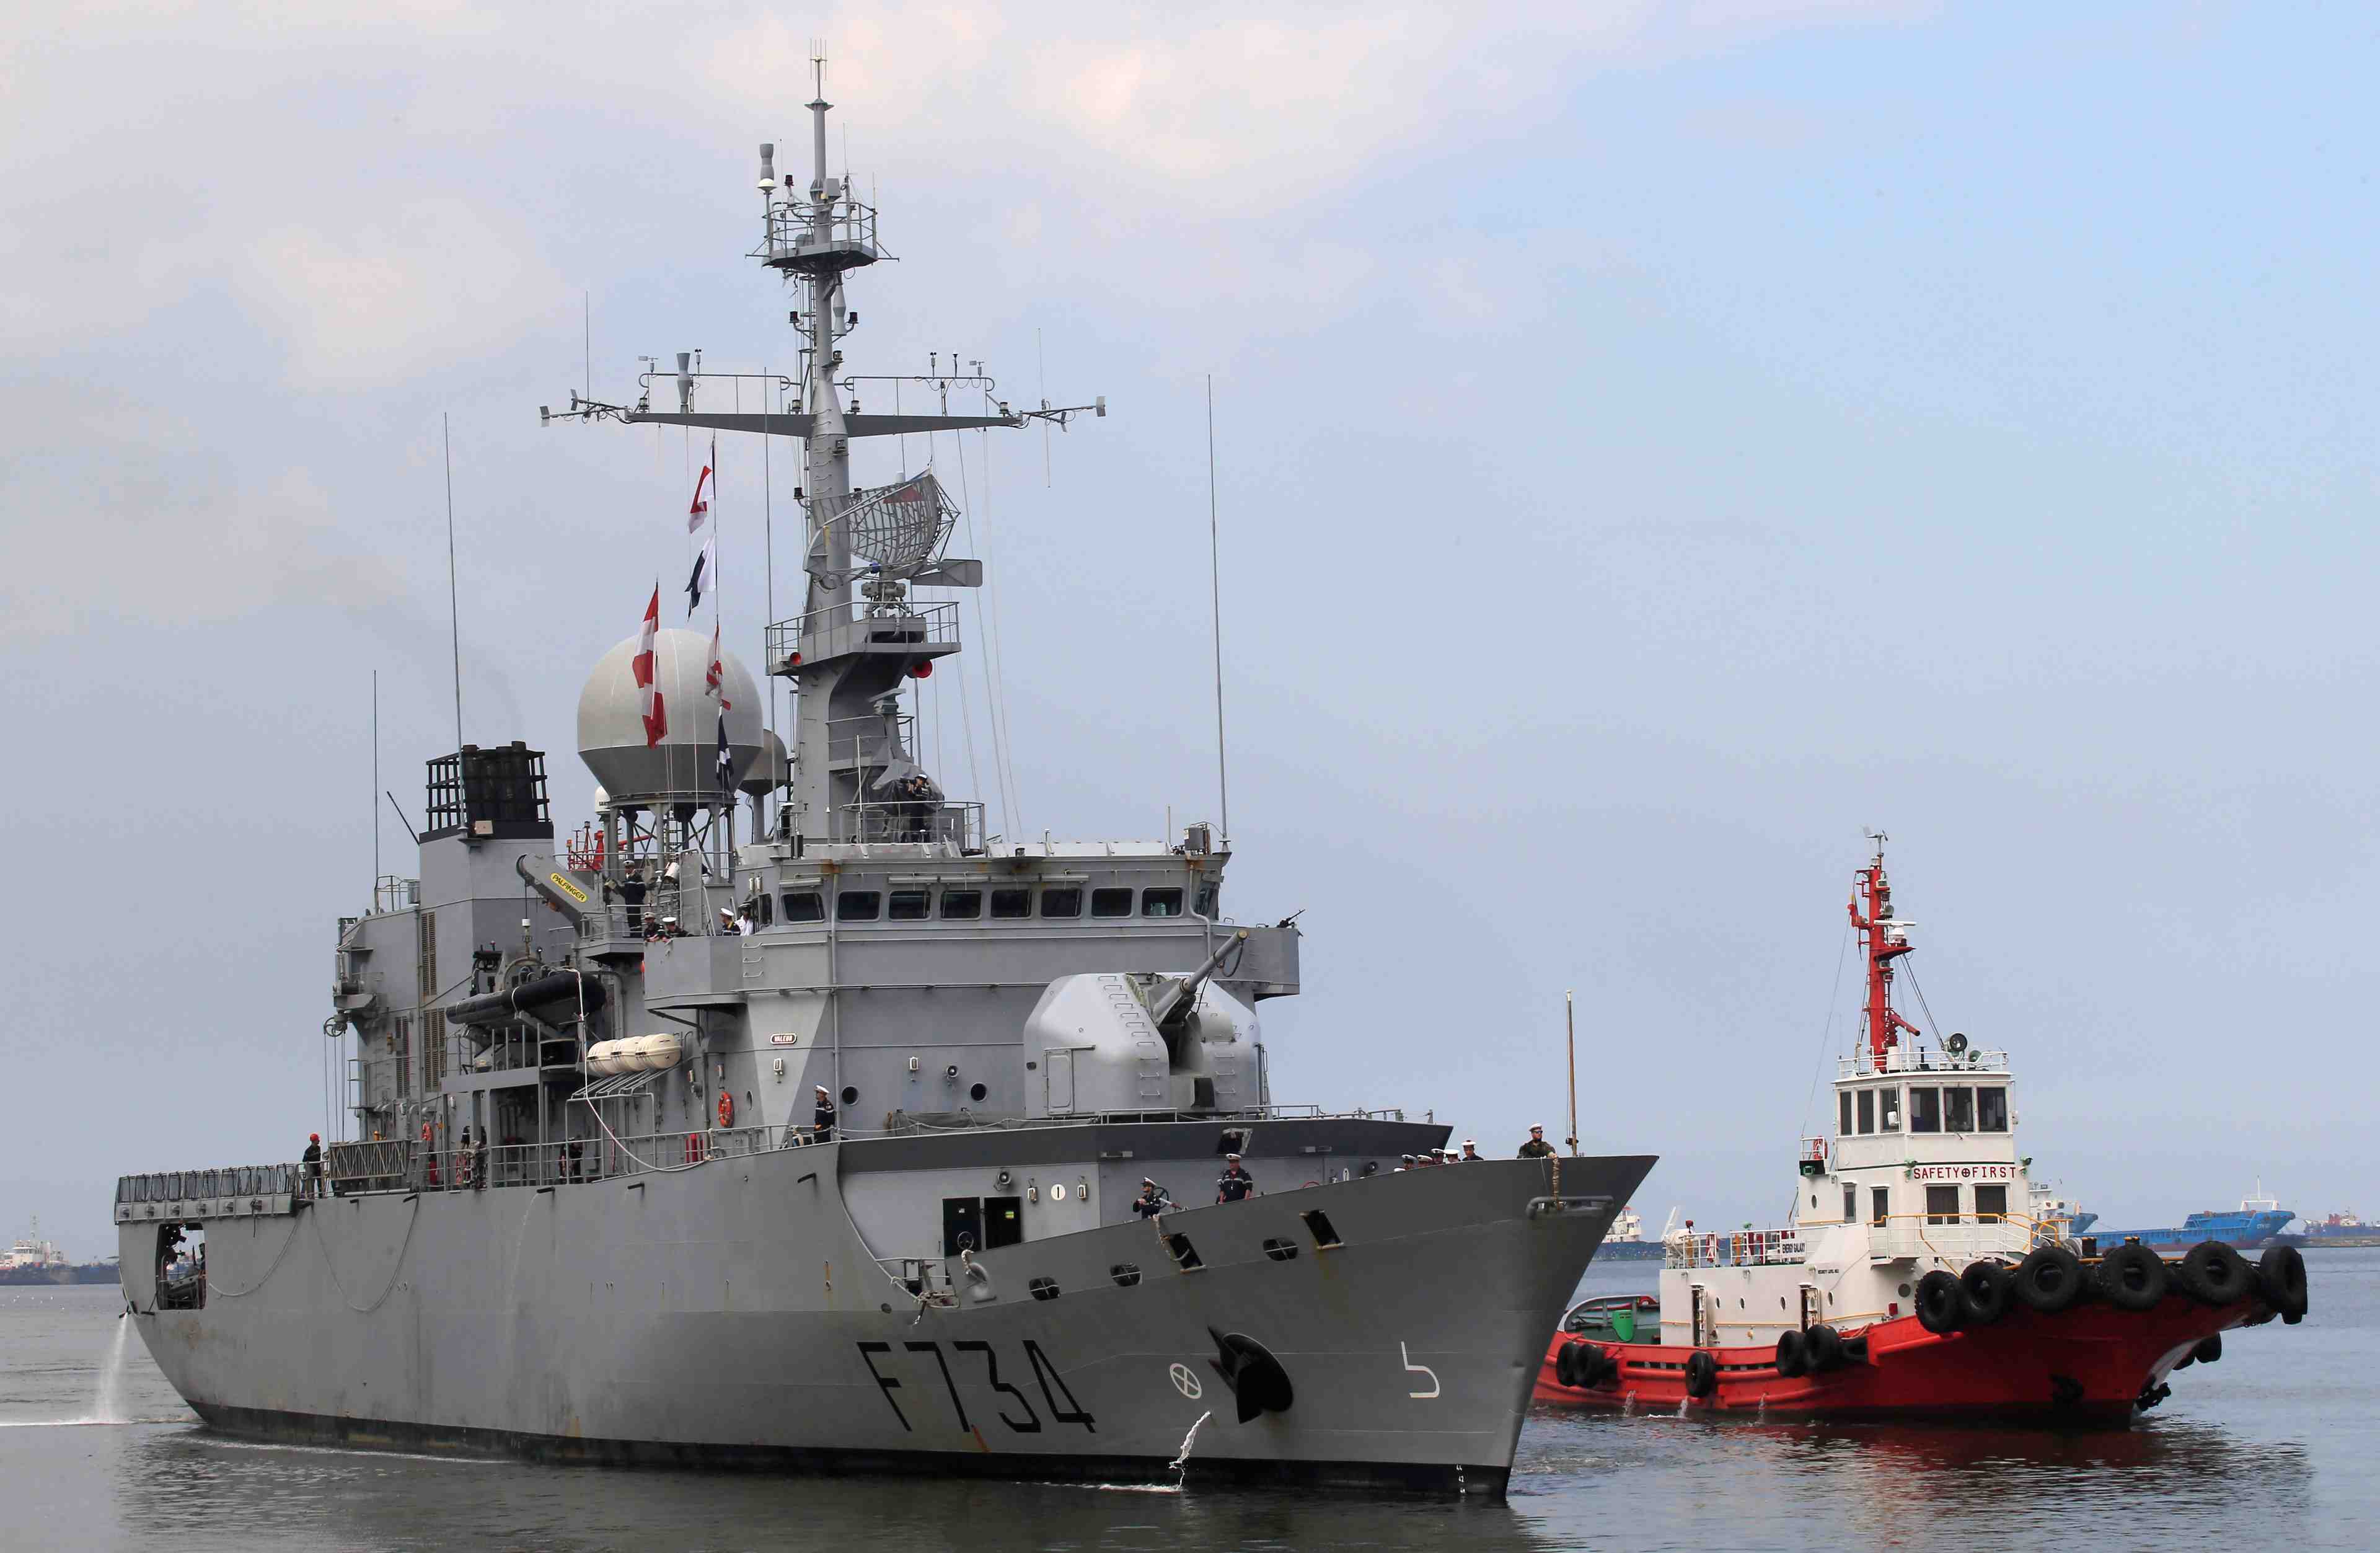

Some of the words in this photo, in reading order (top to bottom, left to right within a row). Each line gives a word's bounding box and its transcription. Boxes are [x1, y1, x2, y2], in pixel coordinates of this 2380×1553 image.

[552, 874, 585, 900] PALFINGER
[1913, 1167, 1959, 1179] SAFETY
[1972, 1167, 2016, 1178] FIRST
[856, 1339, 1096, 1433] F734
